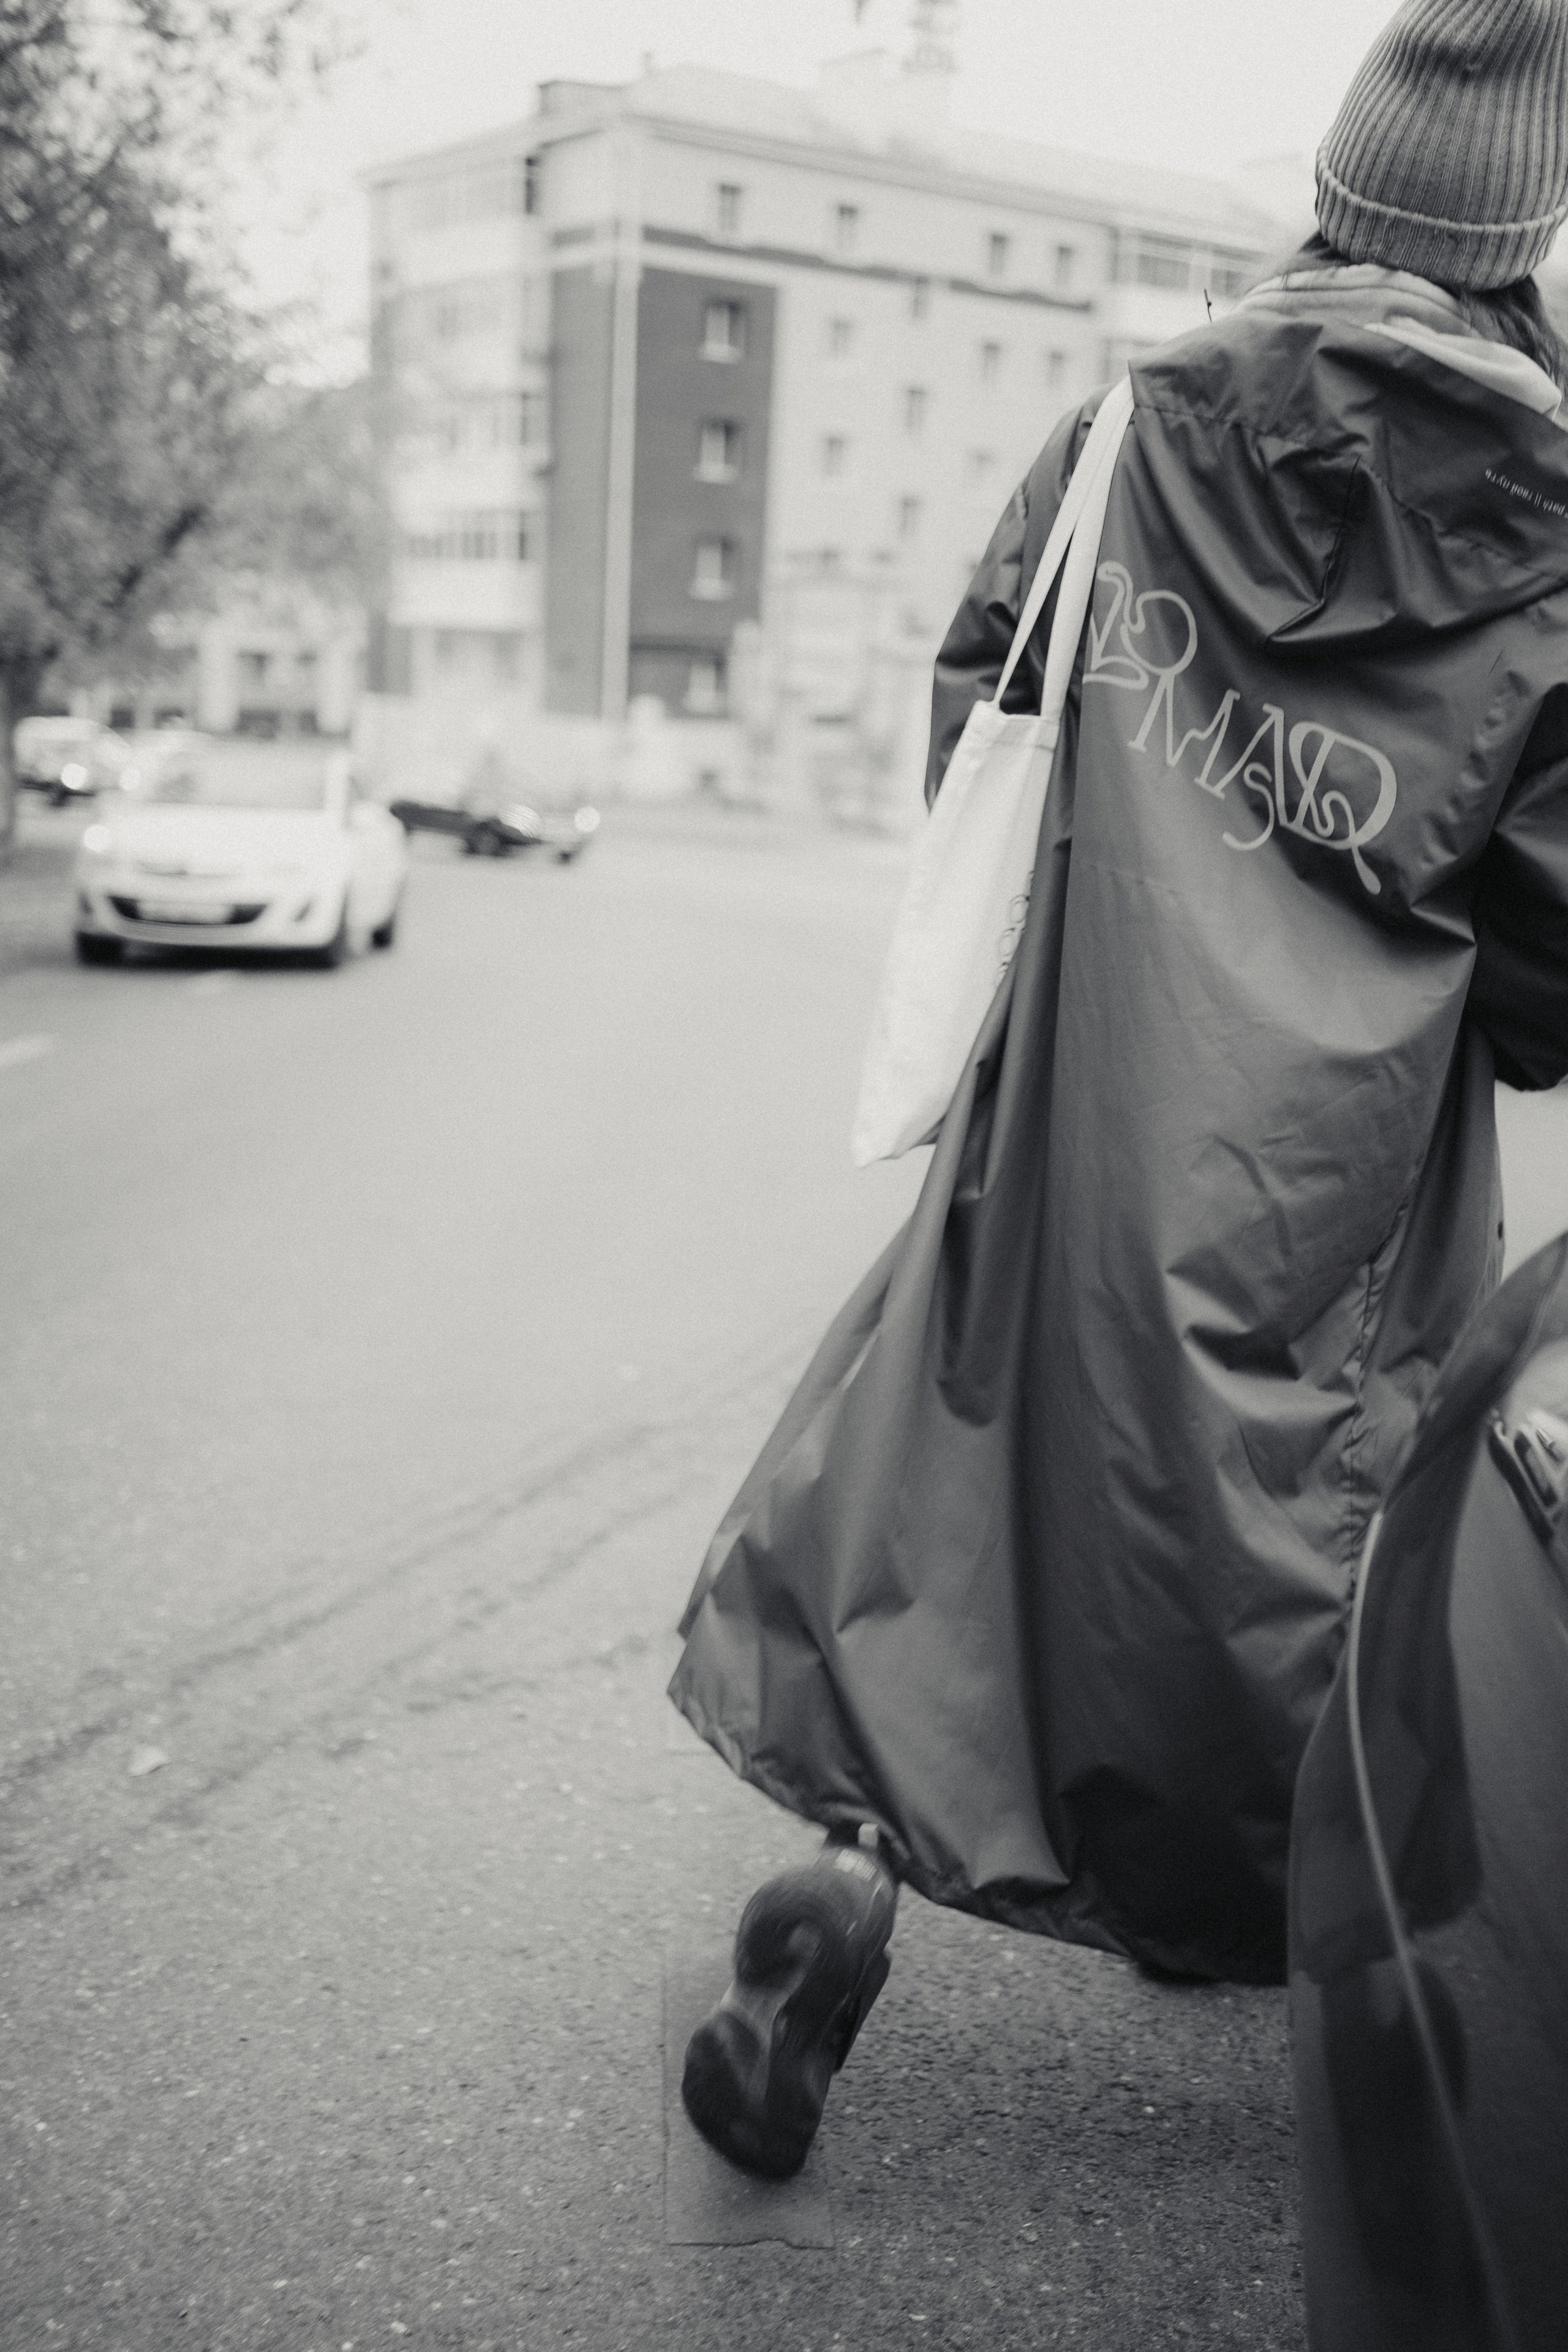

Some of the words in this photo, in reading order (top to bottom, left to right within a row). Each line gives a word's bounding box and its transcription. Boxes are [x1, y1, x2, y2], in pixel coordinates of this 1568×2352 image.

[1485, 469, 1510, 489] путь
[1510, 483, 1533, 501] твой
[1543, 499, 1566, 515] path
